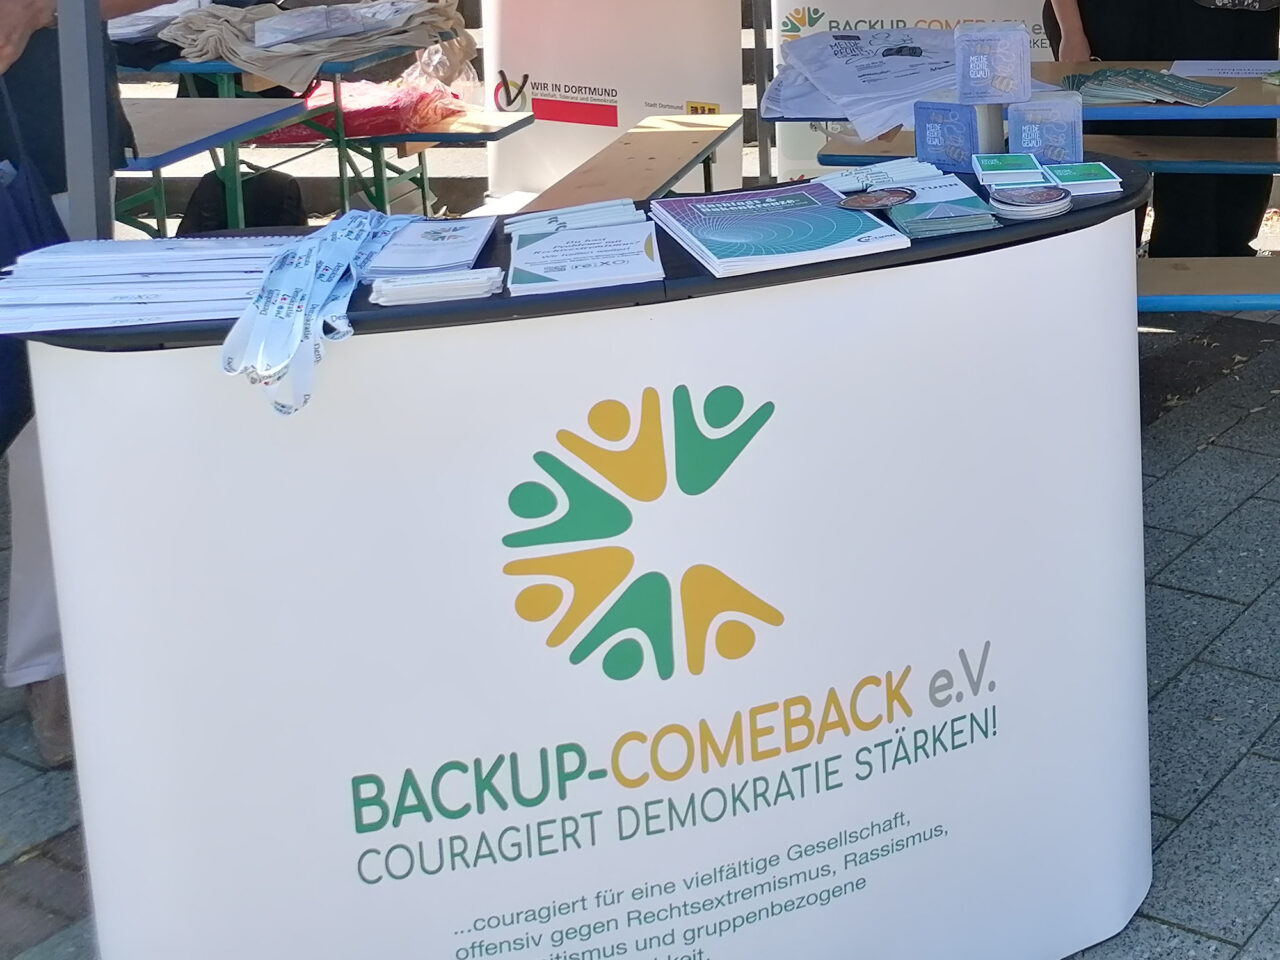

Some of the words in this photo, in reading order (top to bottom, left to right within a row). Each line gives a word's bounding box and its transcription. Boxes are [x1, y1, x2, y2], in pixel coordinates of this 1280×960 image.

[530, 81, 549, 92] WIR
[551, 83, 561, 93] IN
[564, 84, 618, 98] DORTMUND
[658, 102, 684, 111] Dortmund
[351, 665, 914, 835] BACKUP-COMEBACK
[928, 640, 997, 708] e.V.
[356, 809, 603, 885] COURAGIERT
[616, 753, 845, 842] DEMOKRATIE
[853, 703, 999, 781] STÄRKEN!
[454, 894, 588, 936] ...couragiert
[594, 888, 625, 909] für
[631, 880, 676, 901] eine
[682, 853, 781, 892] vielfältige
[786, 811, 912, 862] Gesellschaft,
[455, 932, 543, 960] offensiv
[550, 916, 619, 947] gegen
[627, 863, 837, 928] Rechtsextremismus,
[843, 824, 949, 871] Rassismus,
[635, 929, 676, 952] und
[682, 876, 867, 946] gruppenbezogene
